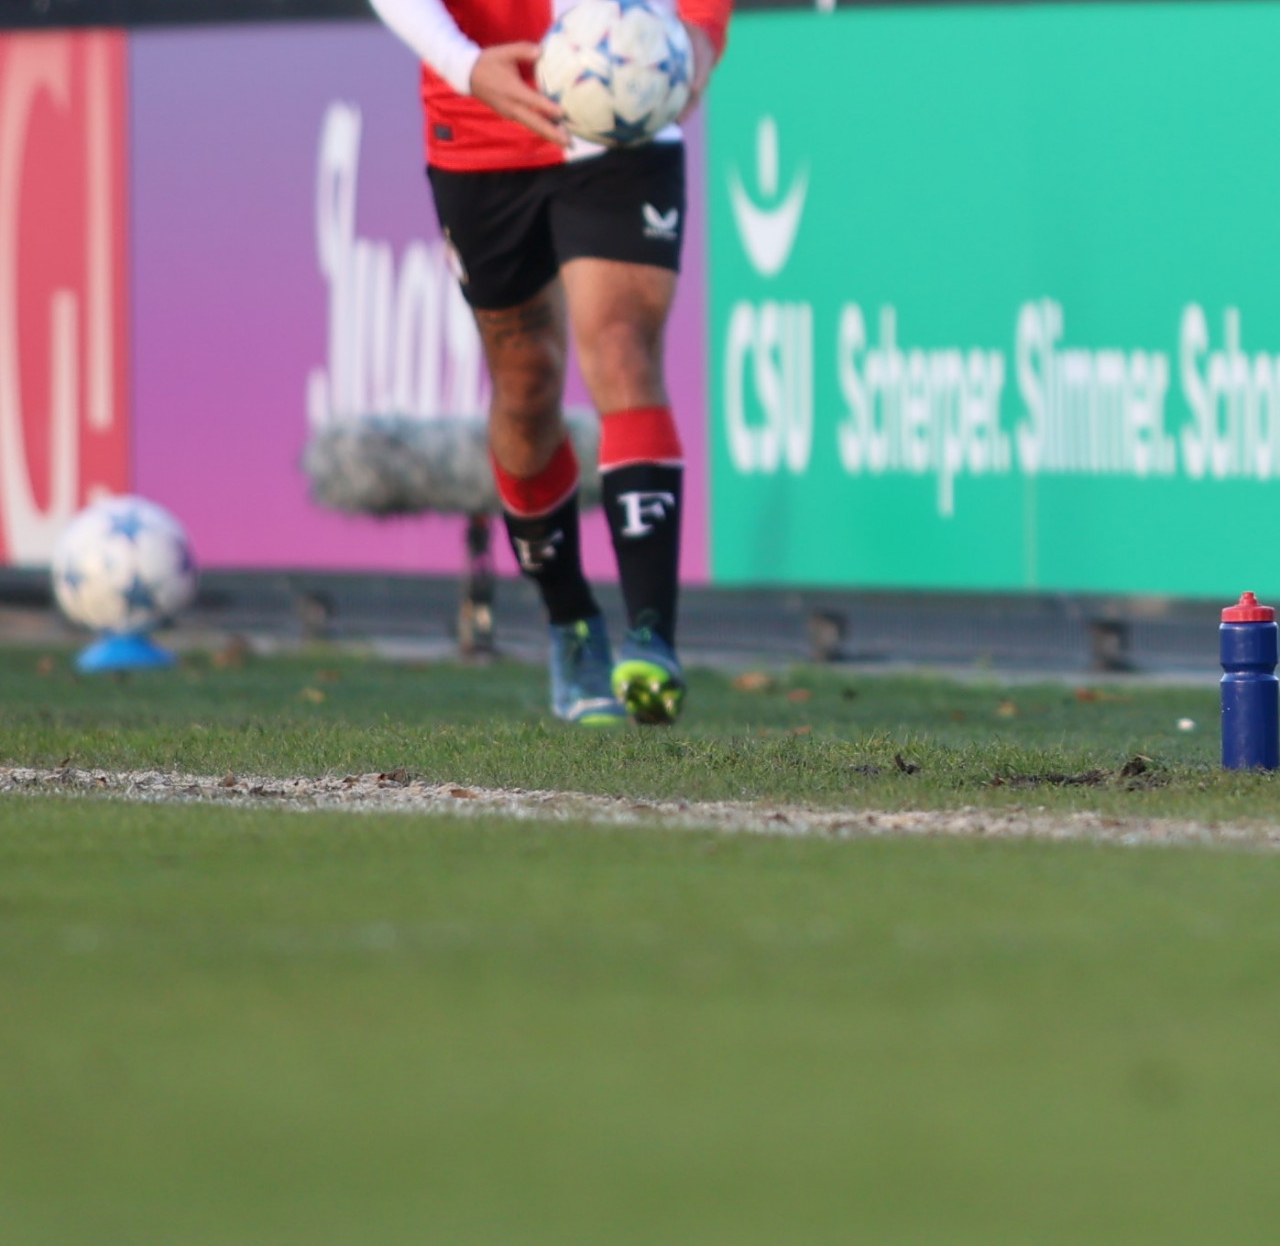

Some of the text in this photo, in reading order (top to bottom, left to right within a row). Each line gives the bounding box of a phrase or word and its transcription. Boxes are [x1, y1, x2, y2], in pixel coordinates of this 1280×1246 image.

[725, 299, 813, 476] CSU
[837, 299, 1011, 519] Scherper.
[615, 490, 676, 538] F
